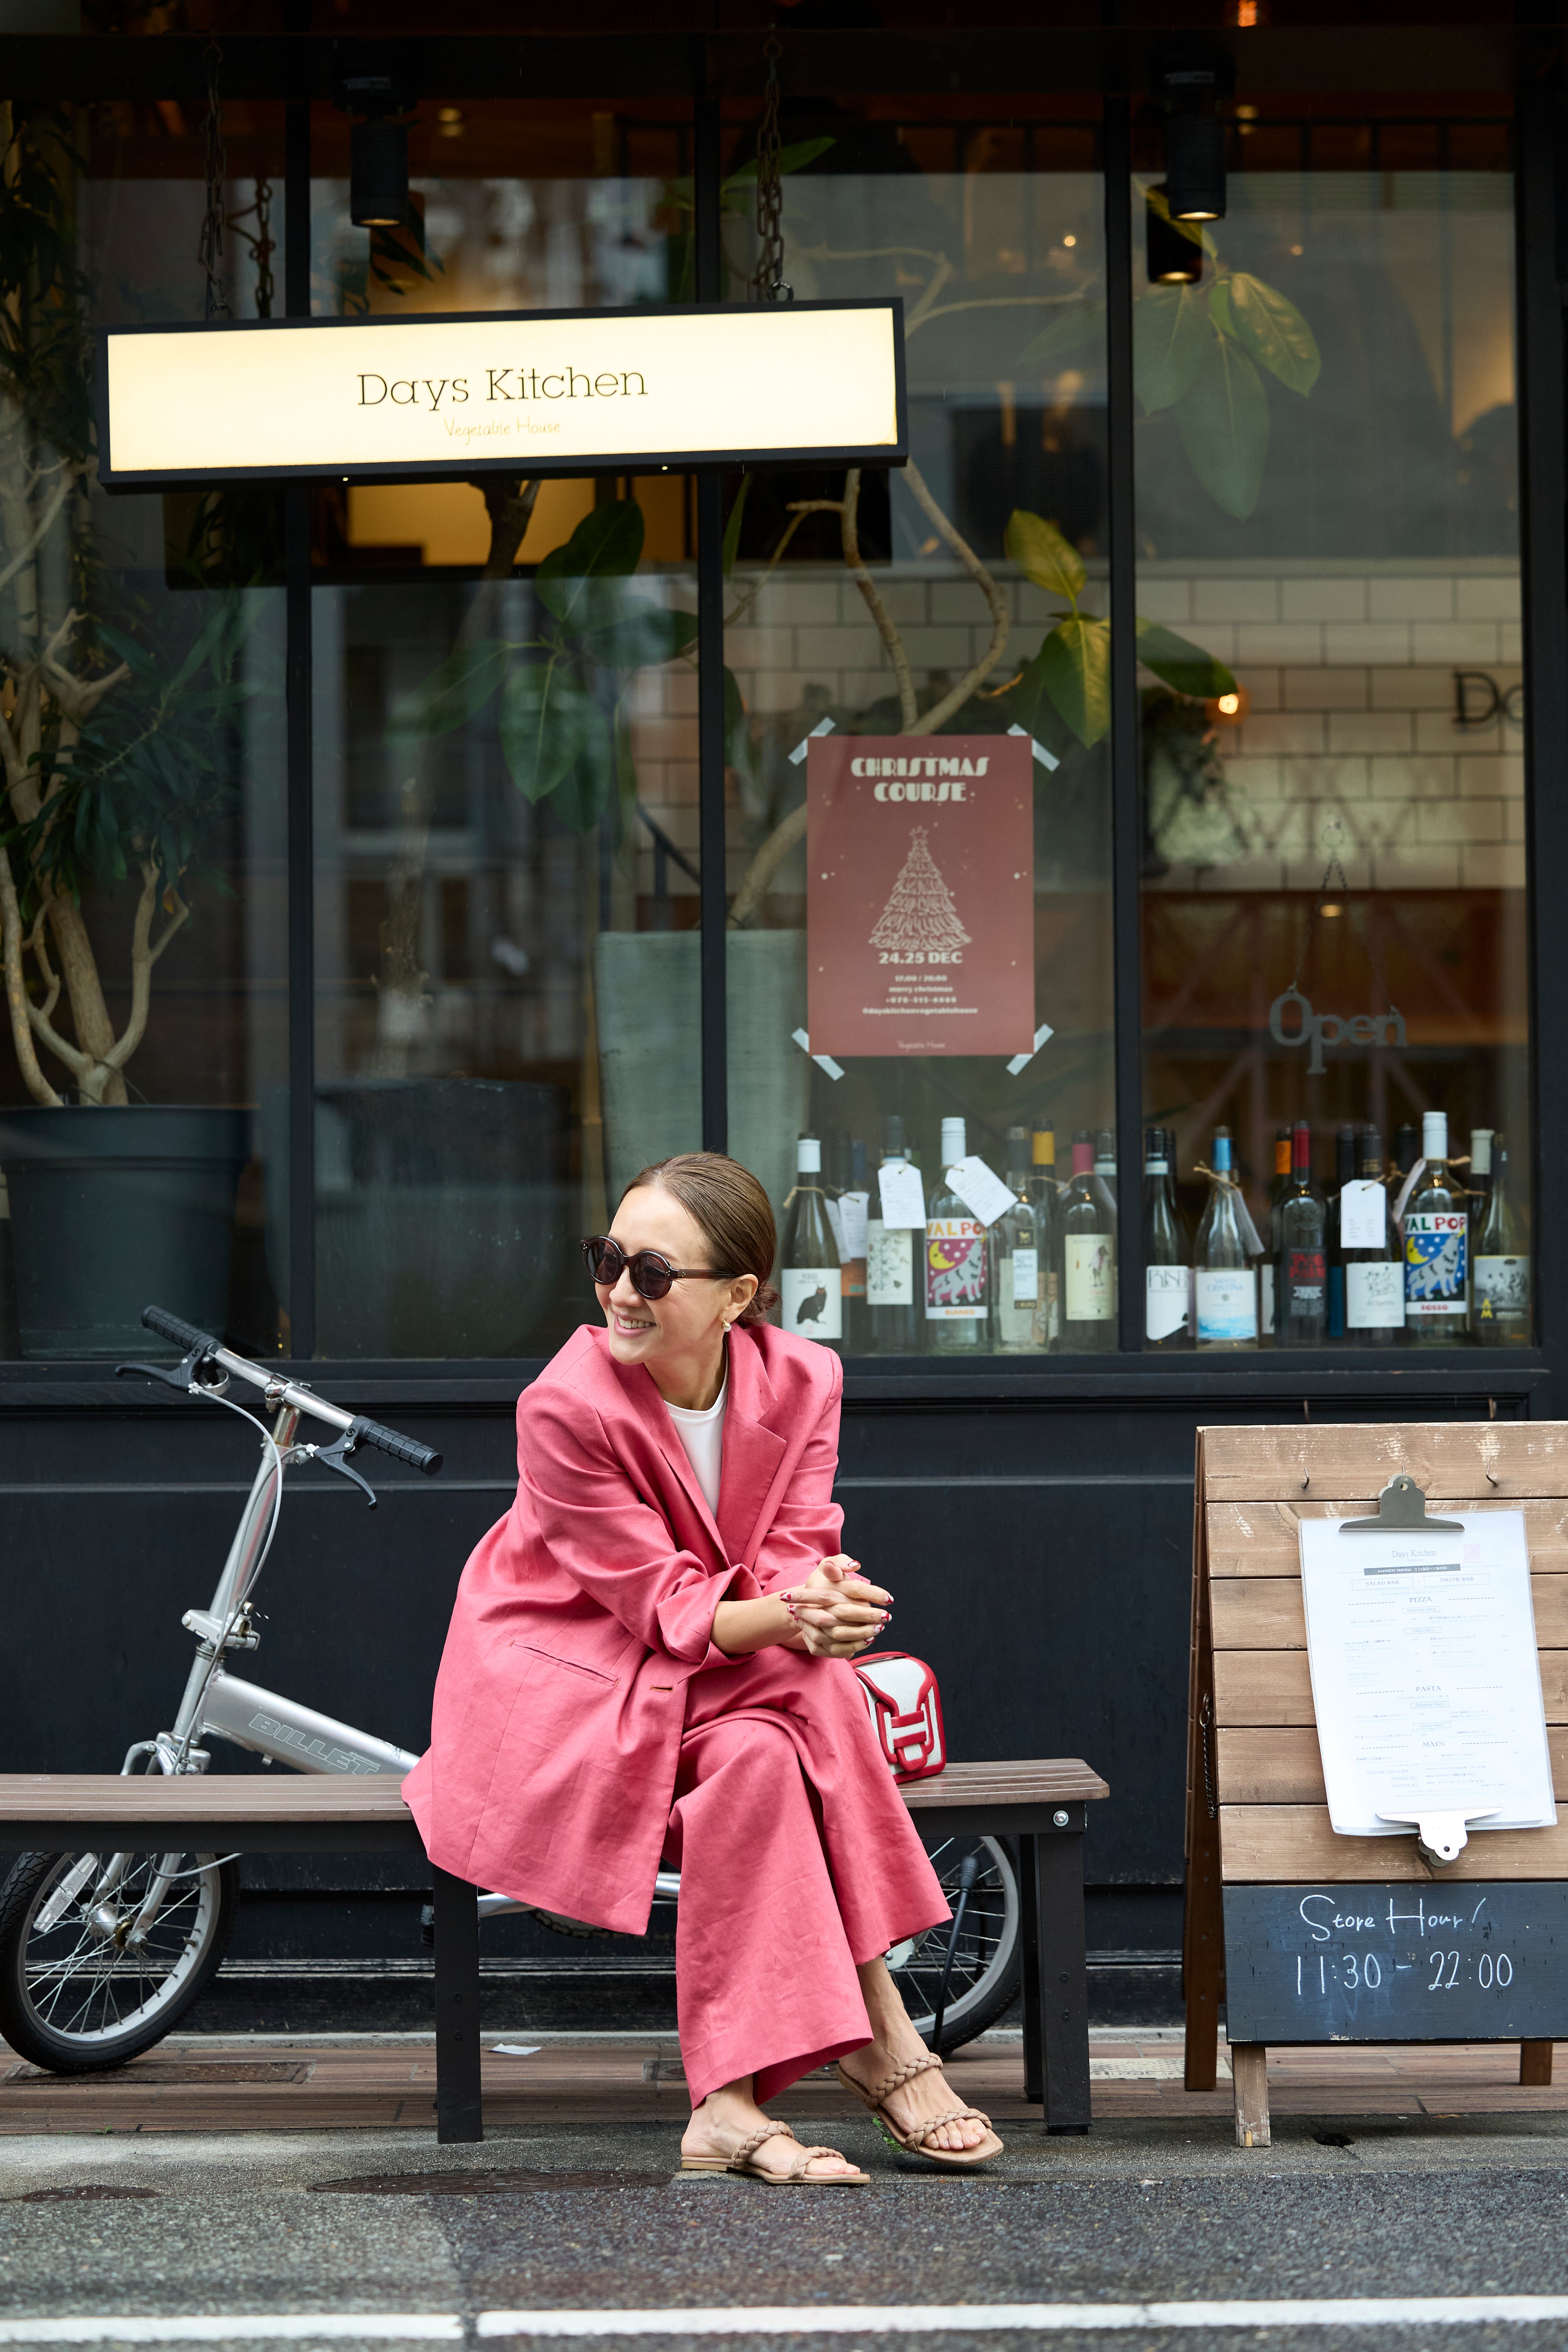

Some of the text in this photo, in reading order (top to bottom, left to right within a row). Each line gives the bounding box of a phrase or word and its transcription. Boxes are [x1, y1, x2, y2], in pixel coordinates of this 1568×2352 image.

[357, 367, 648, 411] Days Kitchen
[444, 415, 561, 445] Vegetable House
[851, 757, 989, 777] CHRISTMAS
[874, 782, 967, 802] COURSE
[879, 951, 963, 964] 24.25 DEC
[1269, 991, 1408, 1075] Open
[1392, 1550, 1409, 1558] Days
[249, 1713, 379, 1775] BILLET
[348, 1751, 381, 1768] aluminum
[1299, 1894, 1375, 1941] Store
[1297, 1953, 1382, 1995] 11:30
[1428, 1950, 1514, 1991] 22:00
